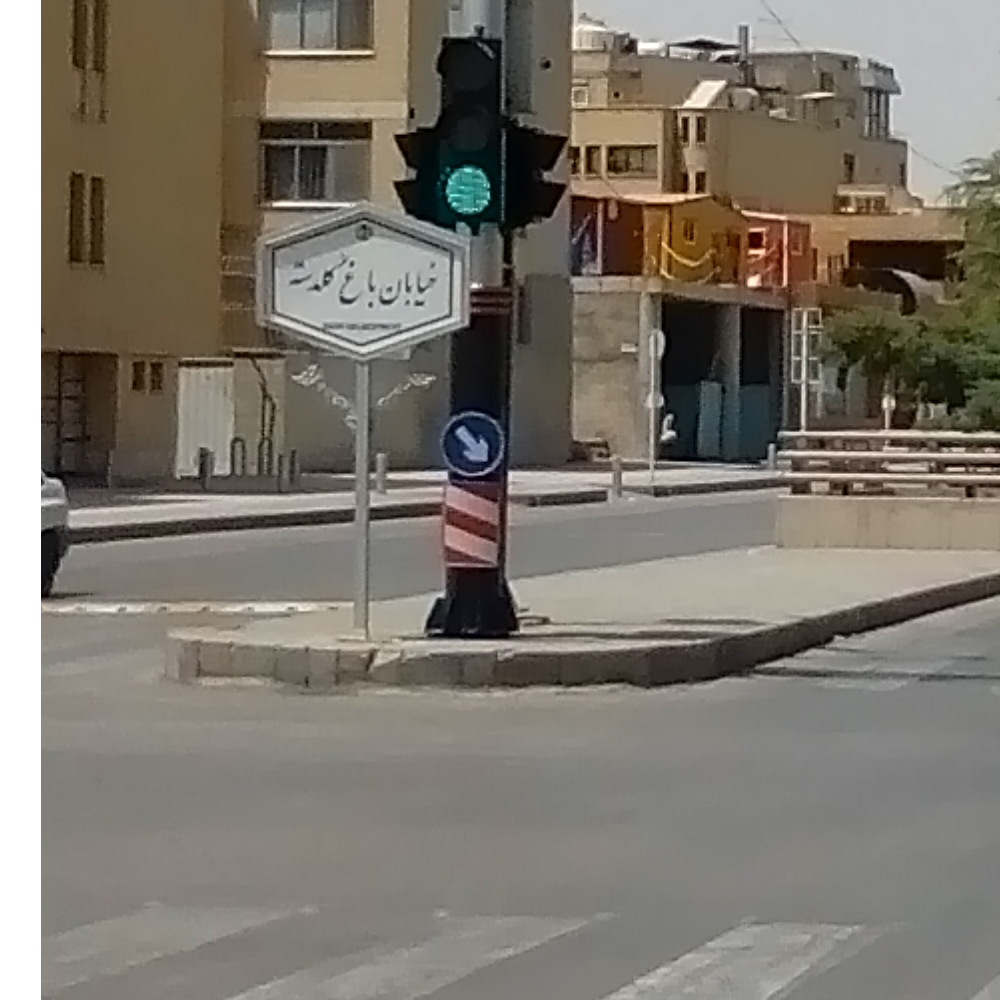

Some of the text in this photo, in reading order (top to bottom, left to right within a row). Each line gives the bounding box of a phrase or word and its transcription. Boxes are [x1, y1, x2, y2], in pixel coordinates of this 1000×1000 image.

[288, 253, 438, 308] خیابان باغ گلدسته
